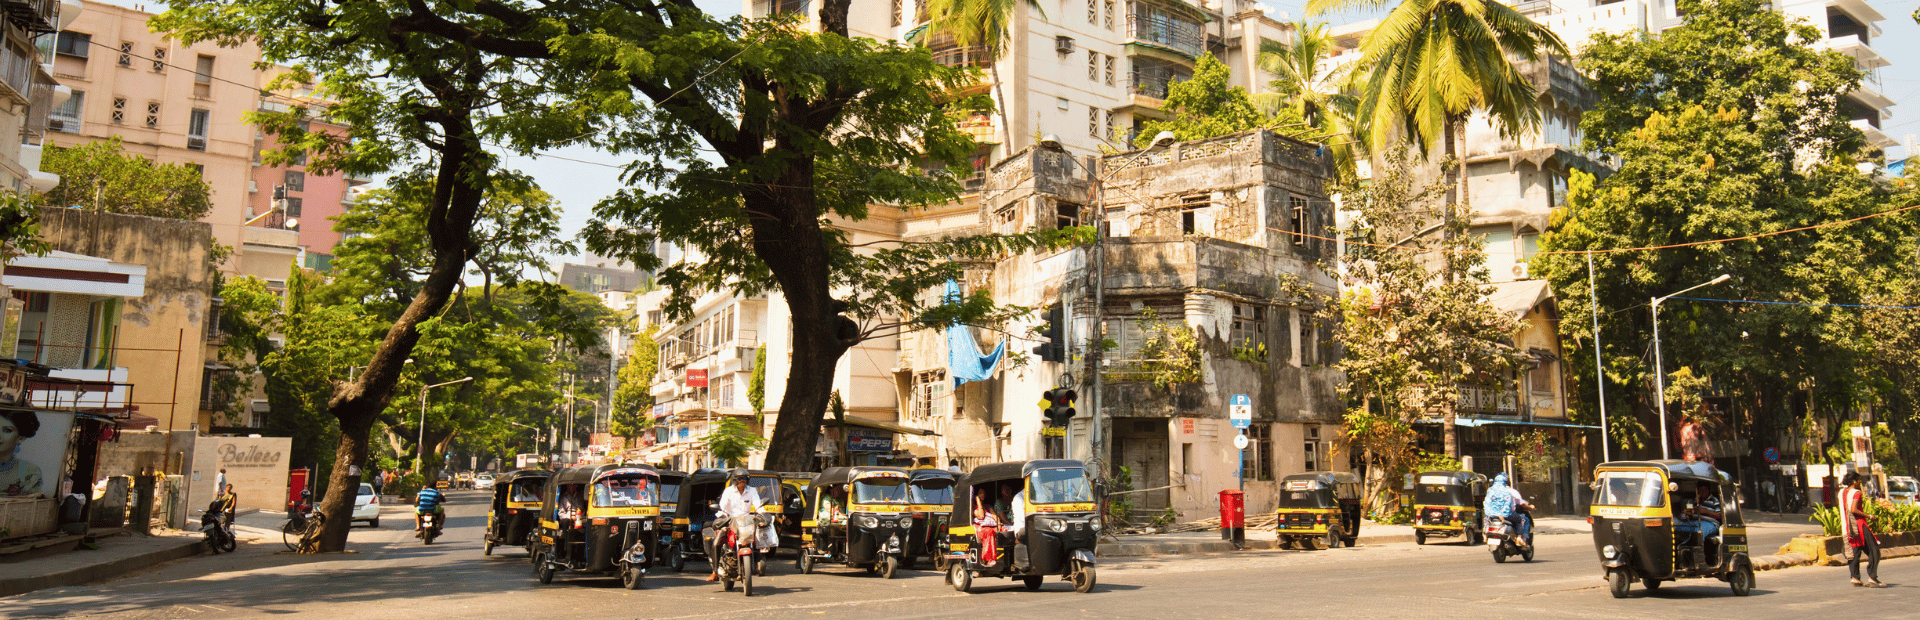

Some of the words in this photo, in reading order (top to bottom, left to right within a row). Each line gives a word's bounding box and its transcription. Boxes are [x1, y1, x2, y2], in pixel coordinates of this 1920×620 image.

[1236, 395, 1245, 405] P
[860, 438, 892, 448] PEPSI
[218, 443, 281, 463] Belleza
[643, 520, 653, 531] CNG
